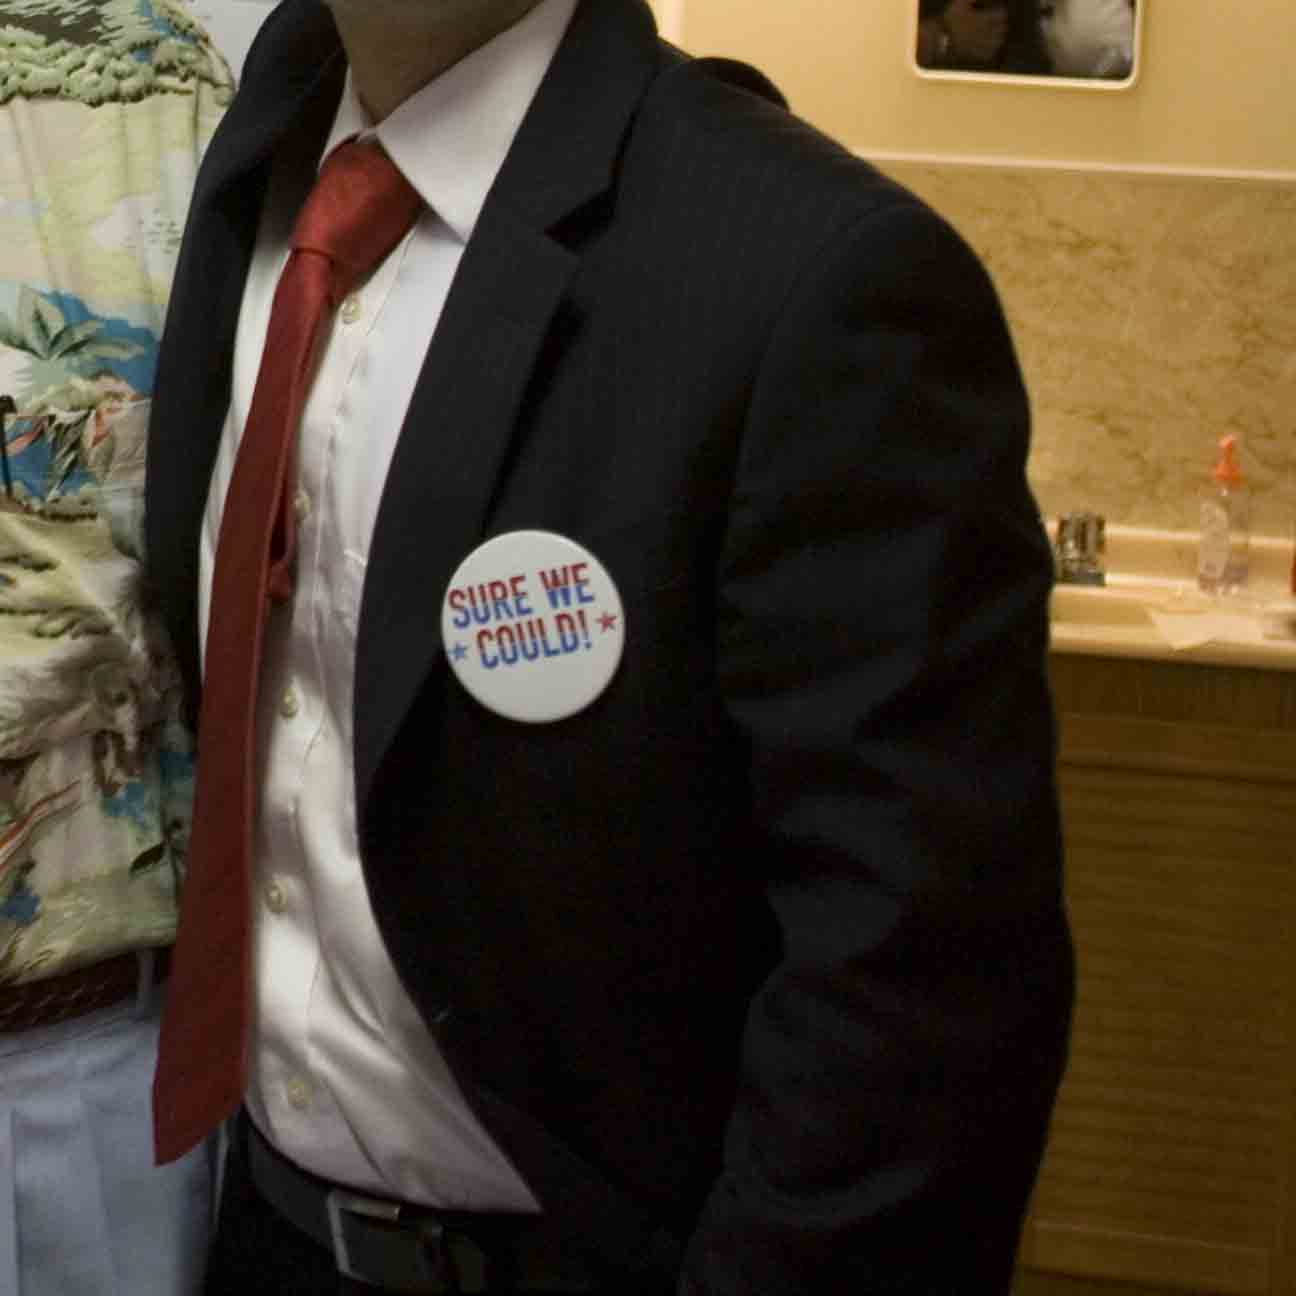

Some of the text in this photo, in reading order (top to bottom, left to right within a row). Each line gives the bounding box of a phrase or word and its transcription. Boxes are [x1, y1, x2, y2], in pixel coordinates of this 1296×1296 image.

[448, 561, 596, 629] SURE WE
[476, 609, 593, 670] COULD!
